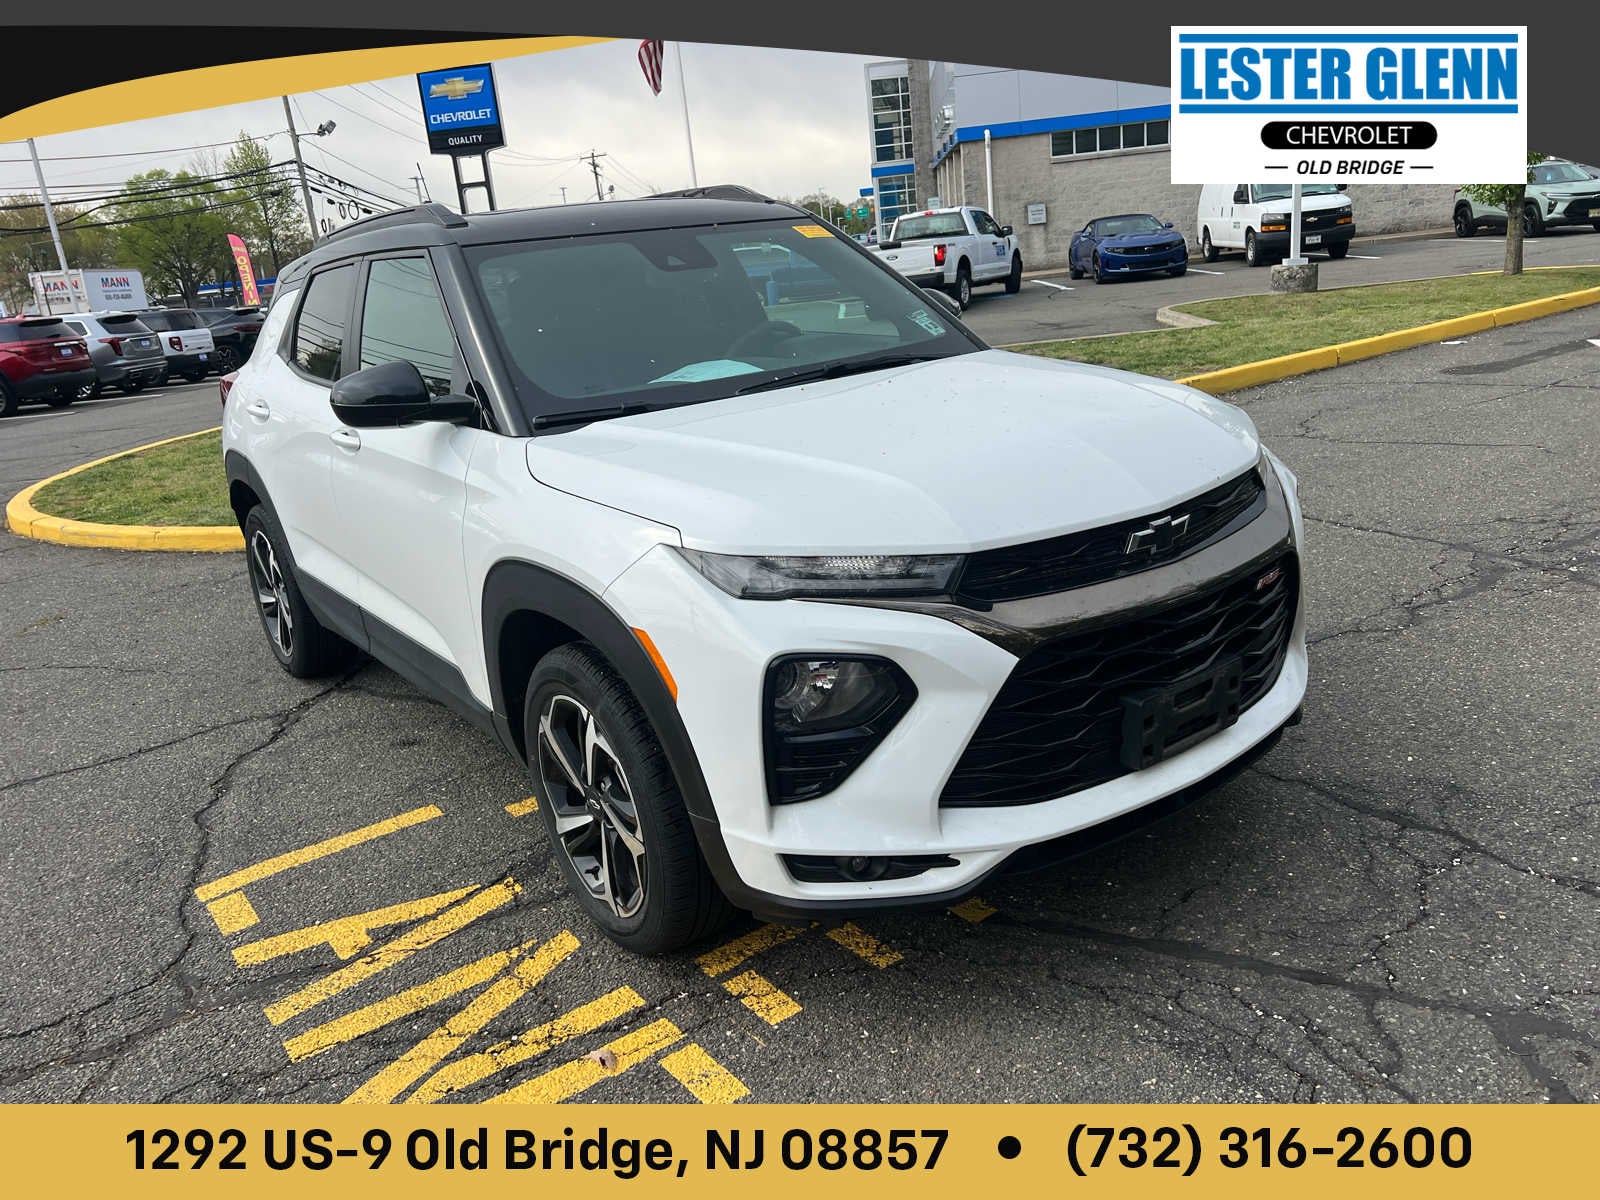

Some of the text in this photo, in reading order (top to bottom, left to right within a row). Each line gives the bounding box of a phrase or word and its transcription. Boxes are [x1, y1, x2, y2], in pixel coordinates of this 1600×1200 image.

[430, 108, 492, 124] CHEVROLET
[447, 134, 483, 146] QUALITY
[100, 277, 131, 288] MANN
